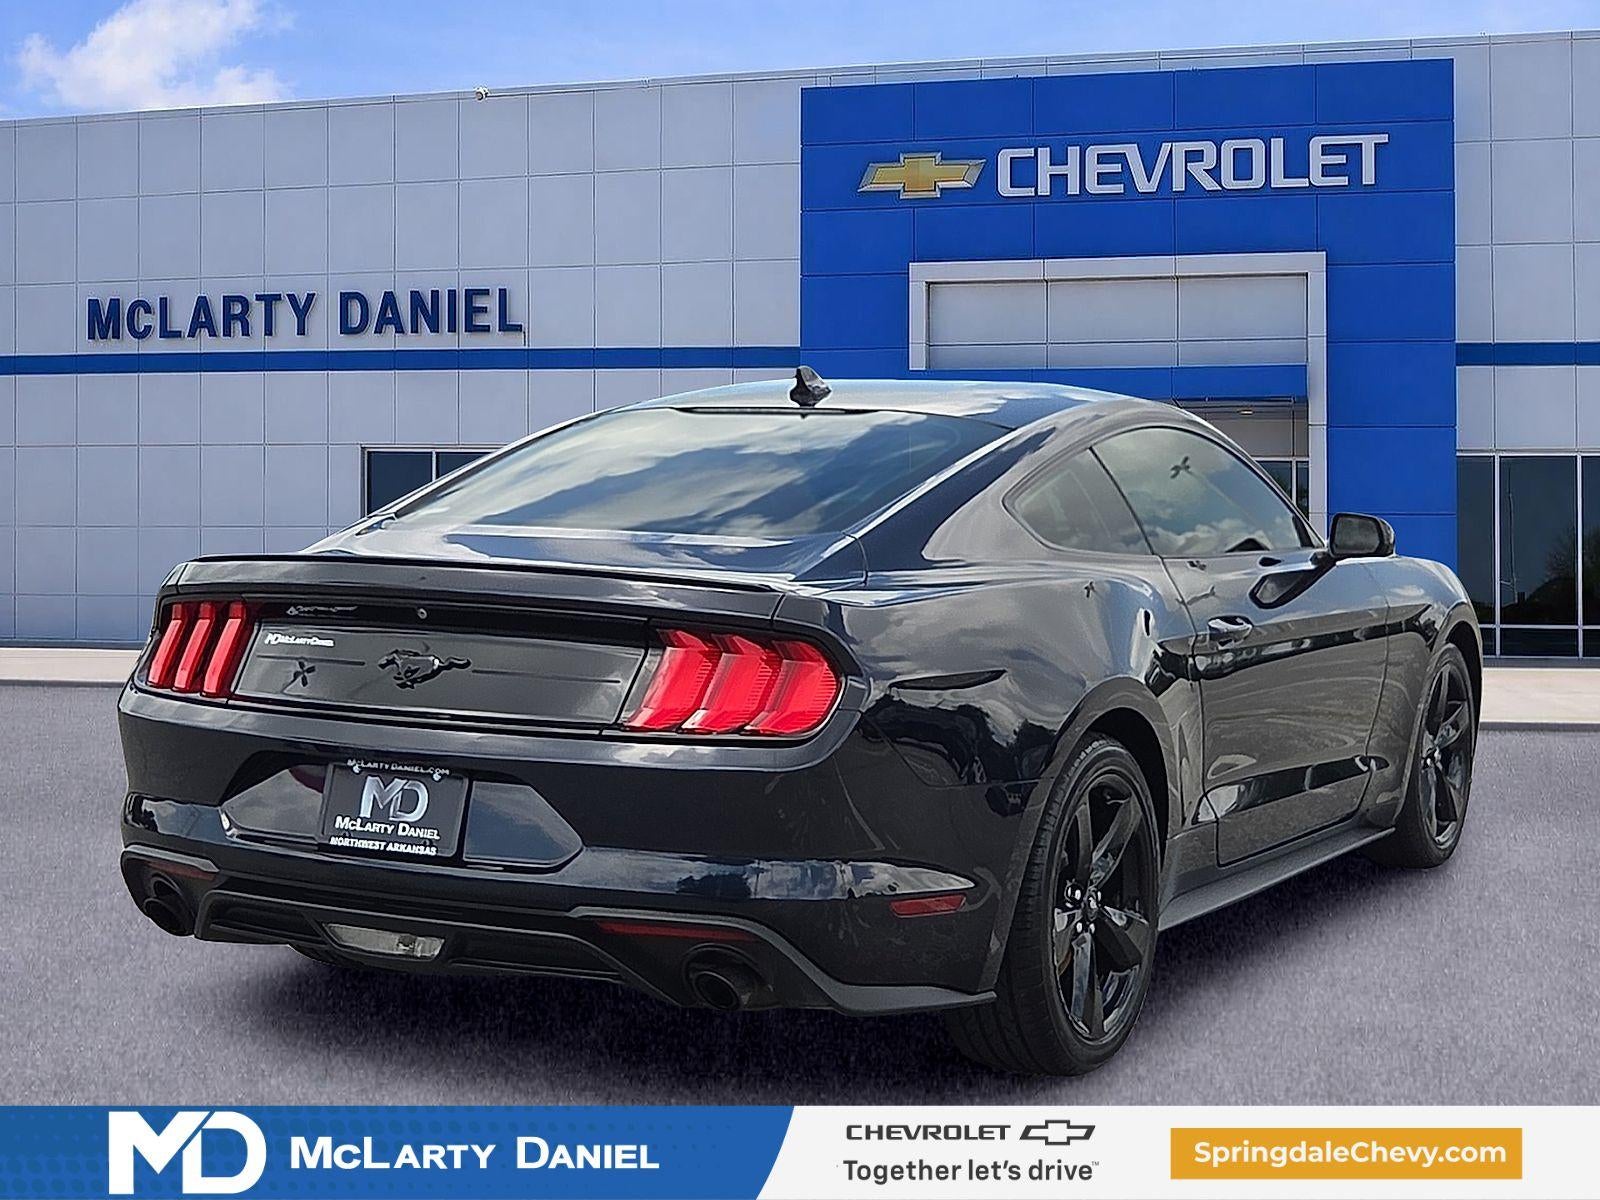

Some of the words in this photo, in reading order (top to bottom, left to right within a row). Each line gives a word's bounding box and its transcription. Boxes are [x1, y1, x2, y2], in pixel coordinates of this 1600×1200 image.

[997, 133, 1389, 197] CHEVROLET
[339, 287, 523, 335] DANIEL
[359, 775, 429, 823] MD
[329, 836, 387, 851] NORTHWEST
[386, 842, 437, 857] ARKANSAS
